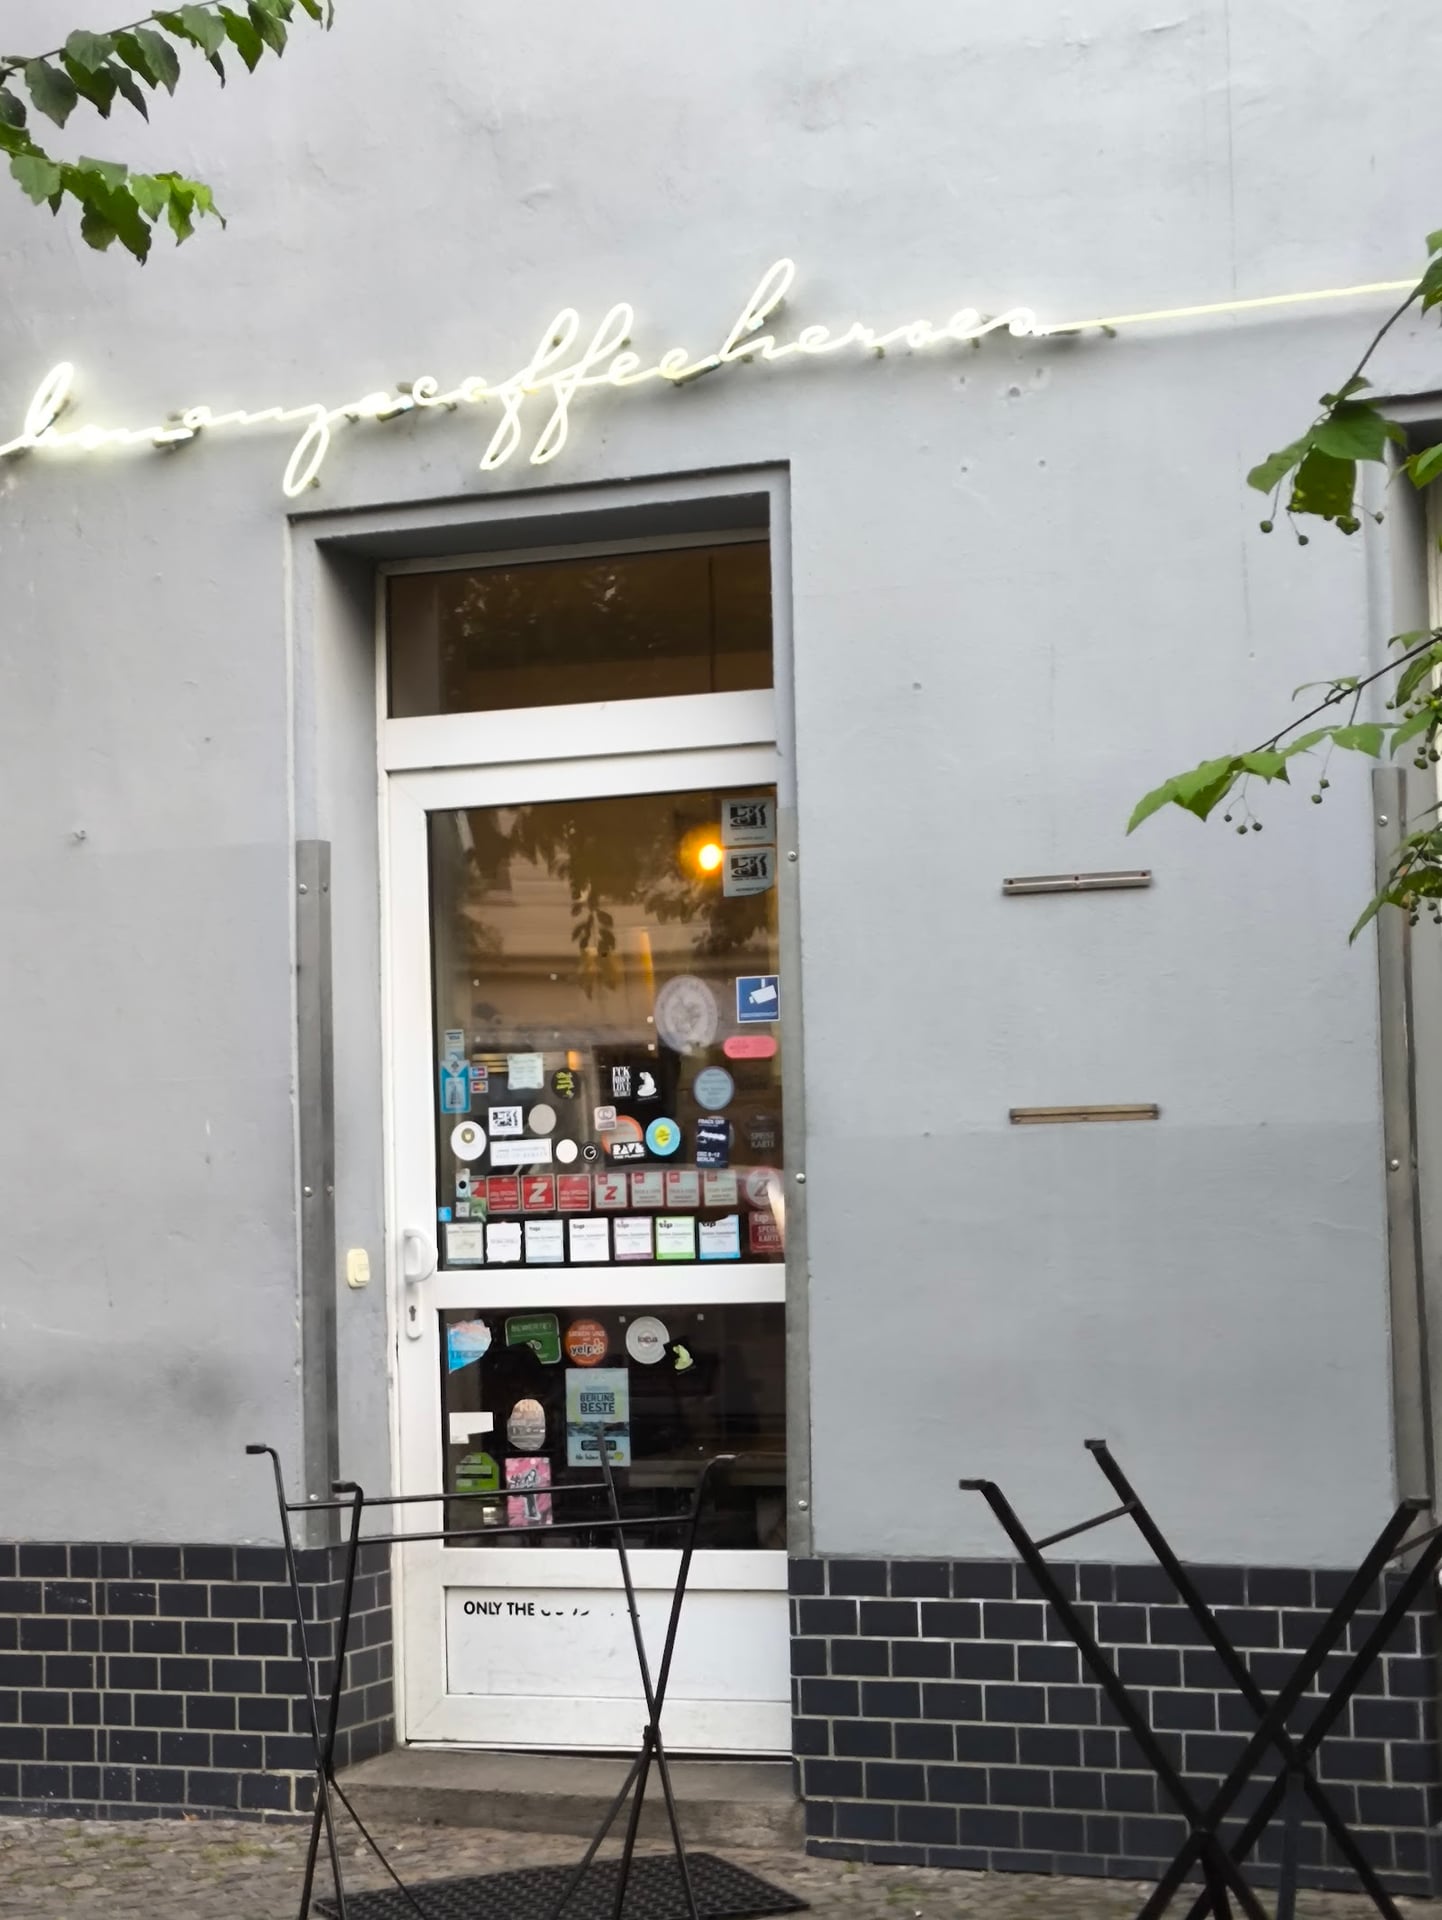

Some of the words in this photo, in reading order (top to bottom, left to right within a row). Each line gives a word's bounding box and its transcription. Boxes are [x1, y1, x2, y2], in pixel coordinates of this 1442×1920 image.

[529, 1182, 548, 1204] Z
[604, 1185, 618, 1201] Z
[570, 1344, 593, 1356] yelp
[579, 1392, 616, 1402] BERLINS
[580, 1402, 616, 1413] BESTE
[463, 1600, 503, 1616] ONLY
[506, 1601, 536, 1617] THE
